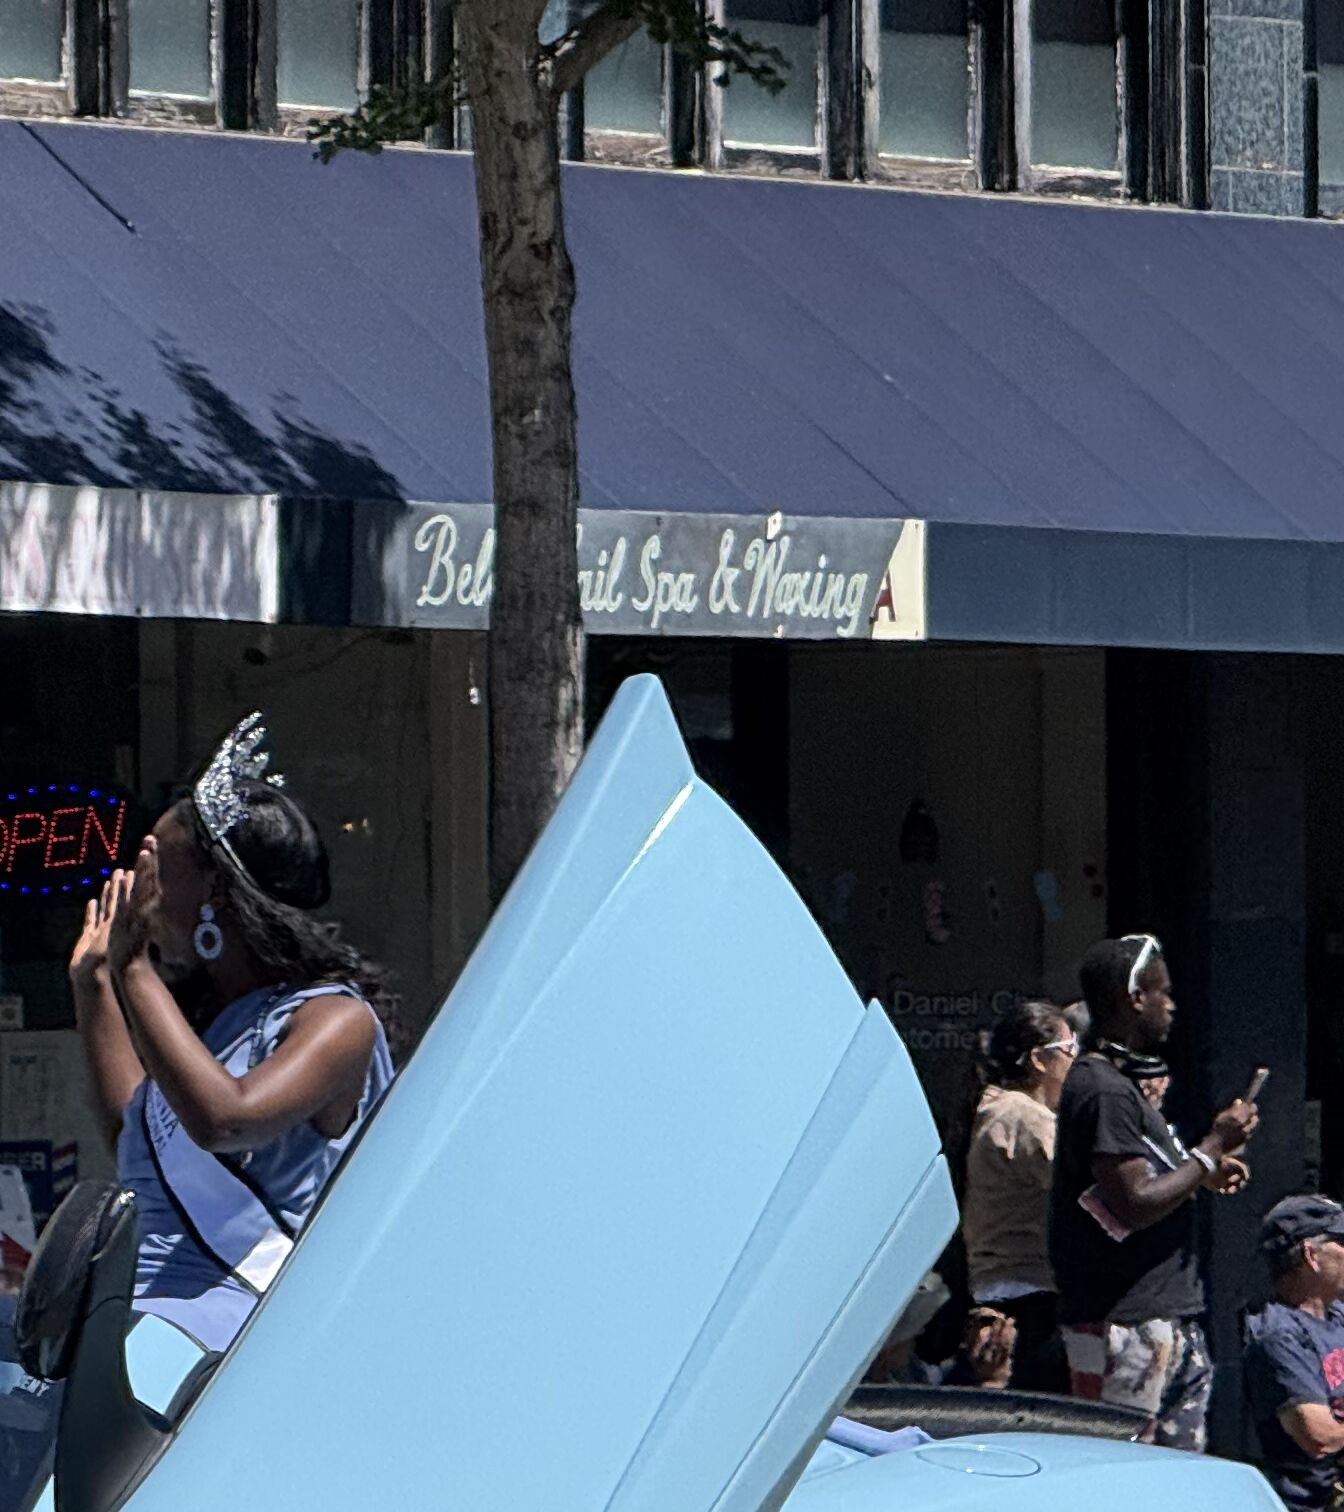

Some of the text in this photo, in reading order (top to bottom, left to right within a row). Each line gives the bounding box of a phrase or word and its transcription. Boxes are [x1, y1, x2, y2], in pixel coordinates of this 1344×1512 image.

[414, 513, 869, 638] Bel ail Spa & Waxing
[894, 989, 978, 1016] Daniel
